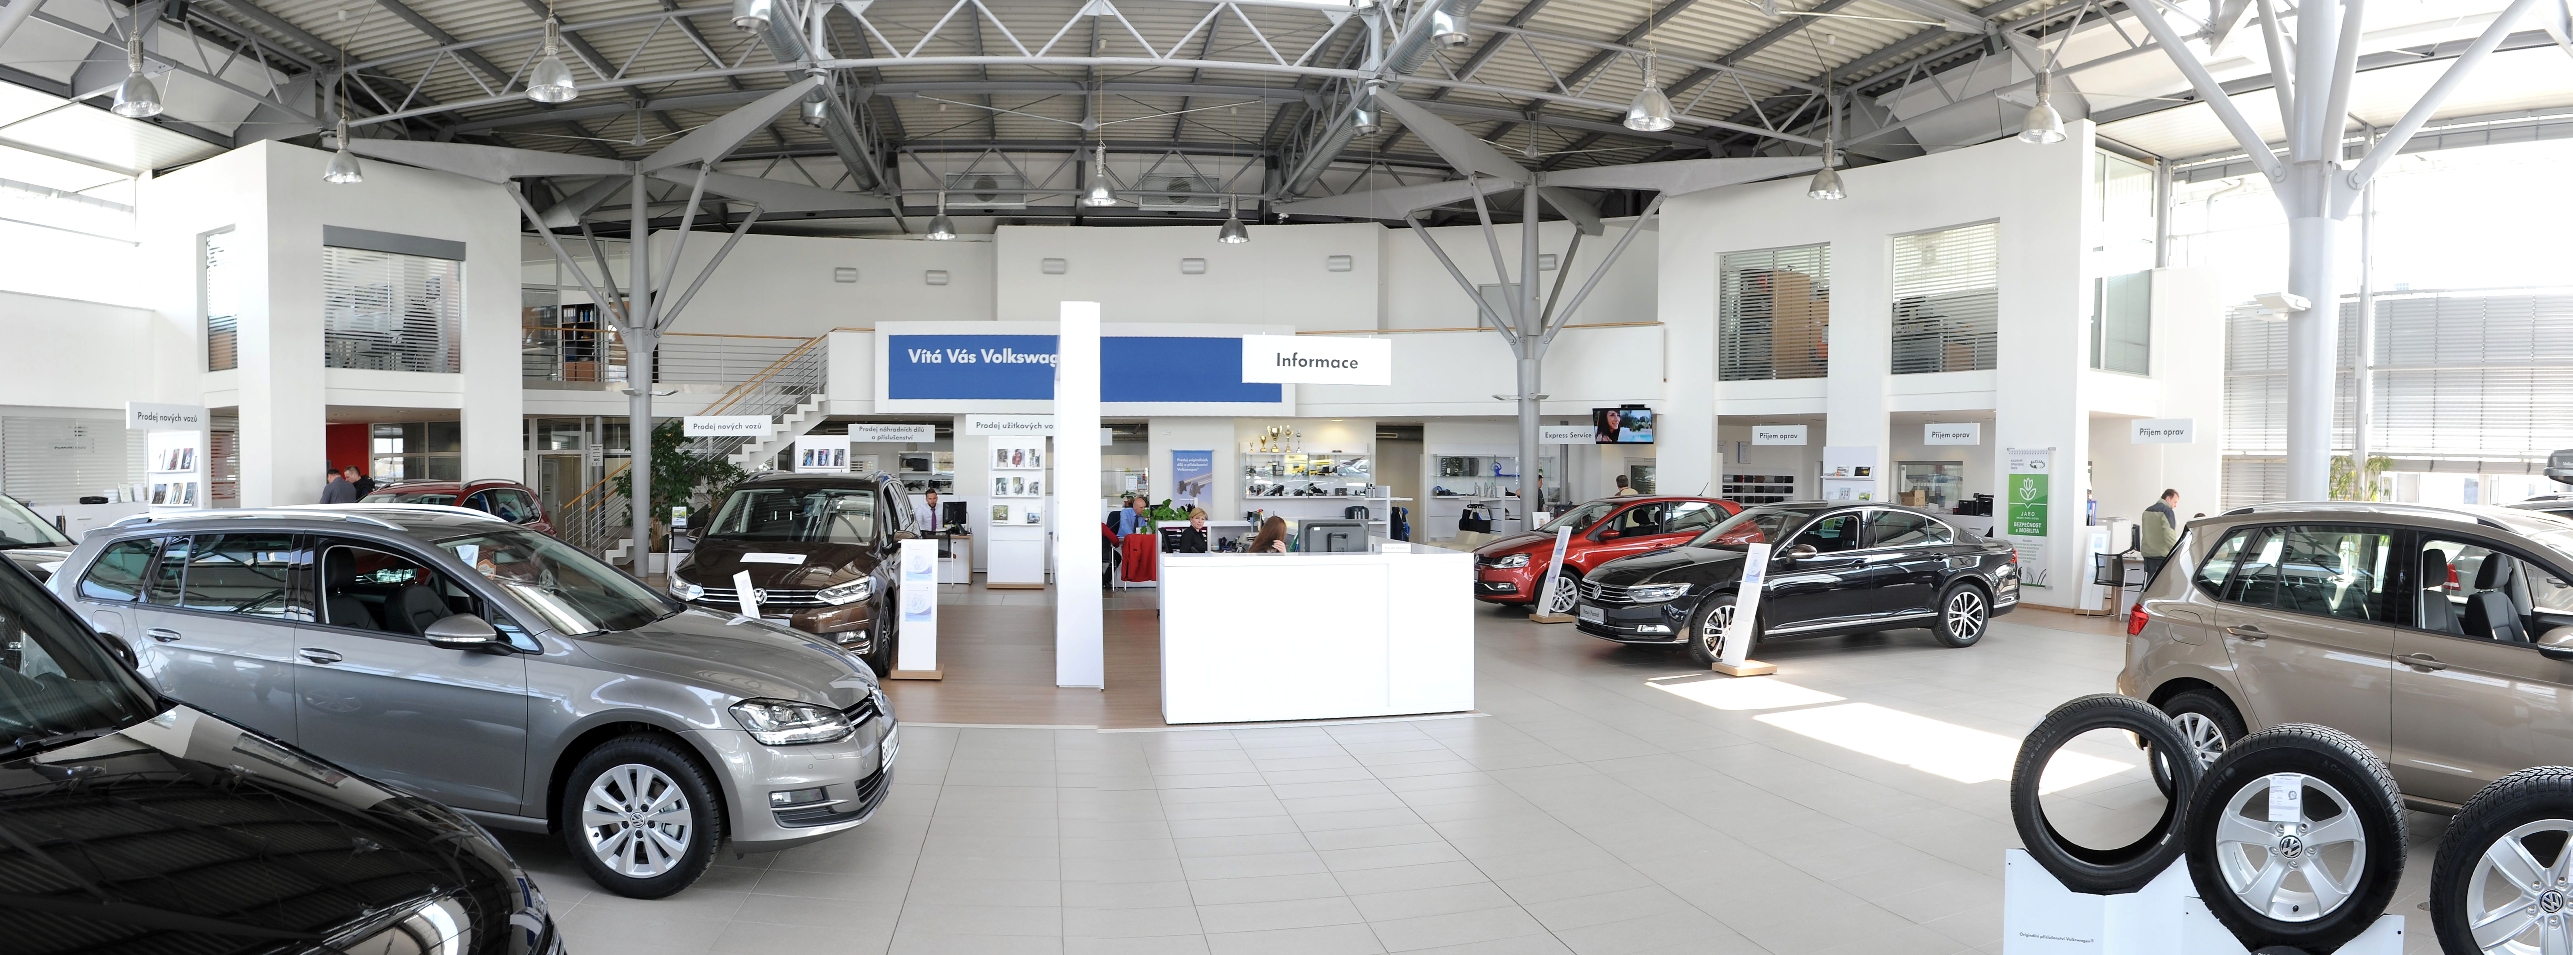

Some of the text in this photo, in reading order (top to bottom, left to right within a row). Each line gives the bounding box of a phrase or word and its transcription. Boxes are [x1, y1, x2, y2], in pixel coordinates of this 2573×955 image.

[908, 347, 1059, 368] Vítá Vás Volkswag
[1276, 351, 1359, 369] Informace
[137, 411, 198, 423] Prodej nových vozů
[693, 422, 716, 431] Prodej
[717, 422, 743, 431] nových
[858, 425, 925, 433] Prodej náhradních dílů
[976, 421, 1001, 430] Prodej
[1002, 421, 1042, 430] užitkových
[1545, 431, 1592, 440] Express Service
[1759, 432, 1779, 441] Příjem
[1931, 431, 1971, 440] Příjem oprav
[2139, 427, 2185, 438] Příjem oprav
